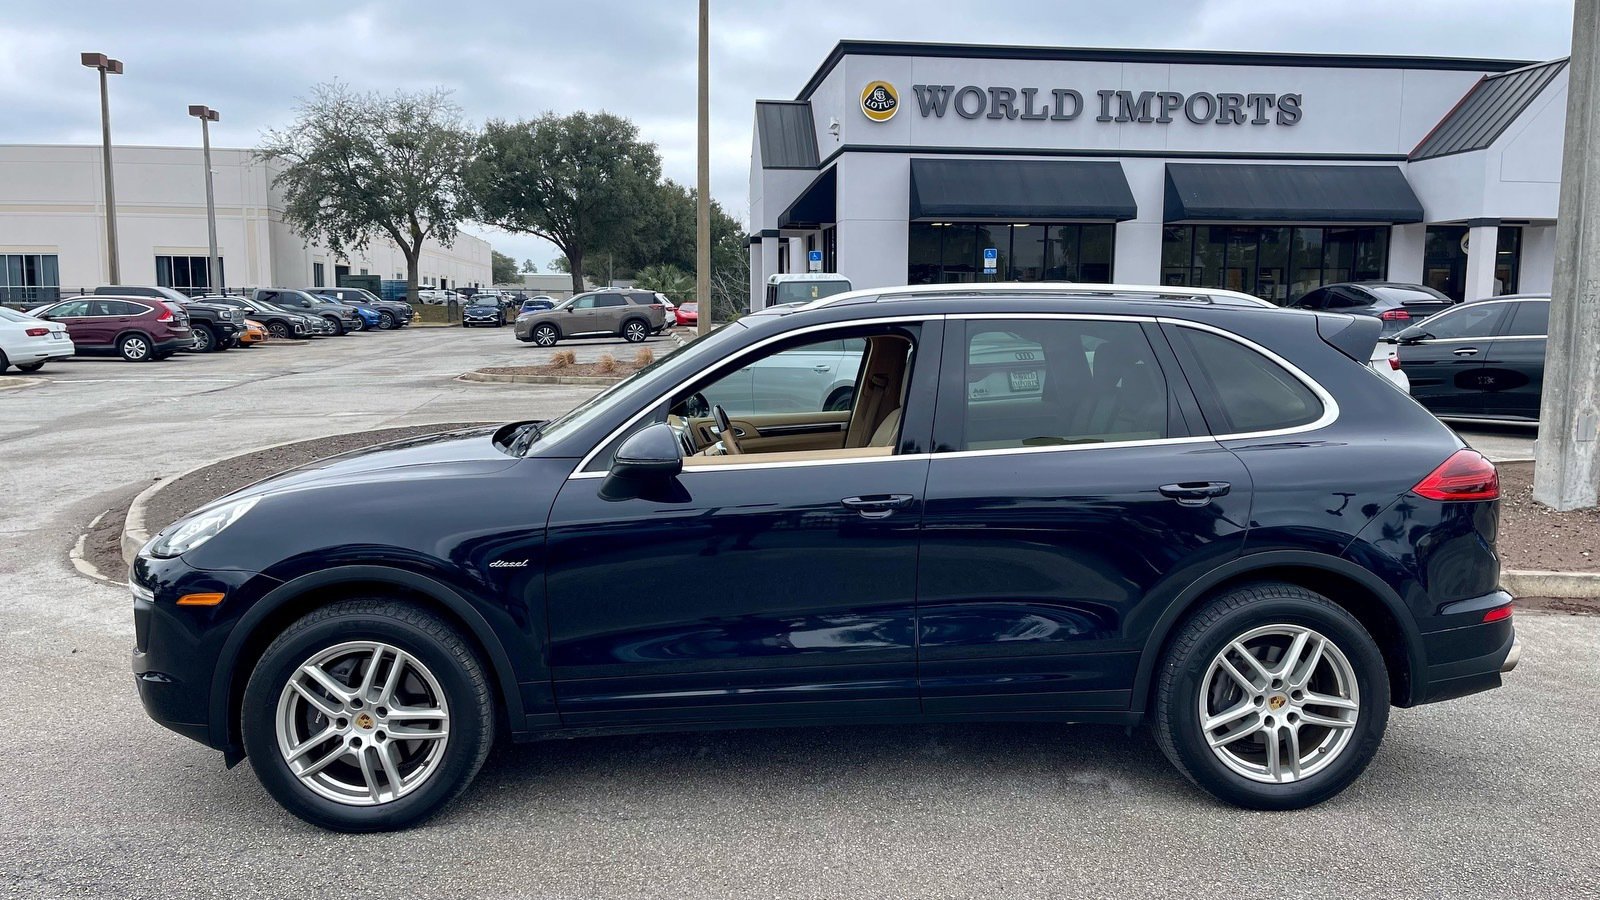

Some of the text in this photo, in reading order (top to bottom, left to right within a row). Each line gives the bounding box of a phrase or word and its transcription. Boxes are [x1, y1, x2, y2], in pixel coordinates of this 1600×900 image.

[866, 98, 895, 110] LOTUS
[912, 84, 1303, 126] WORLD IMPORTS
[489, 559, 529, 568] diesel
